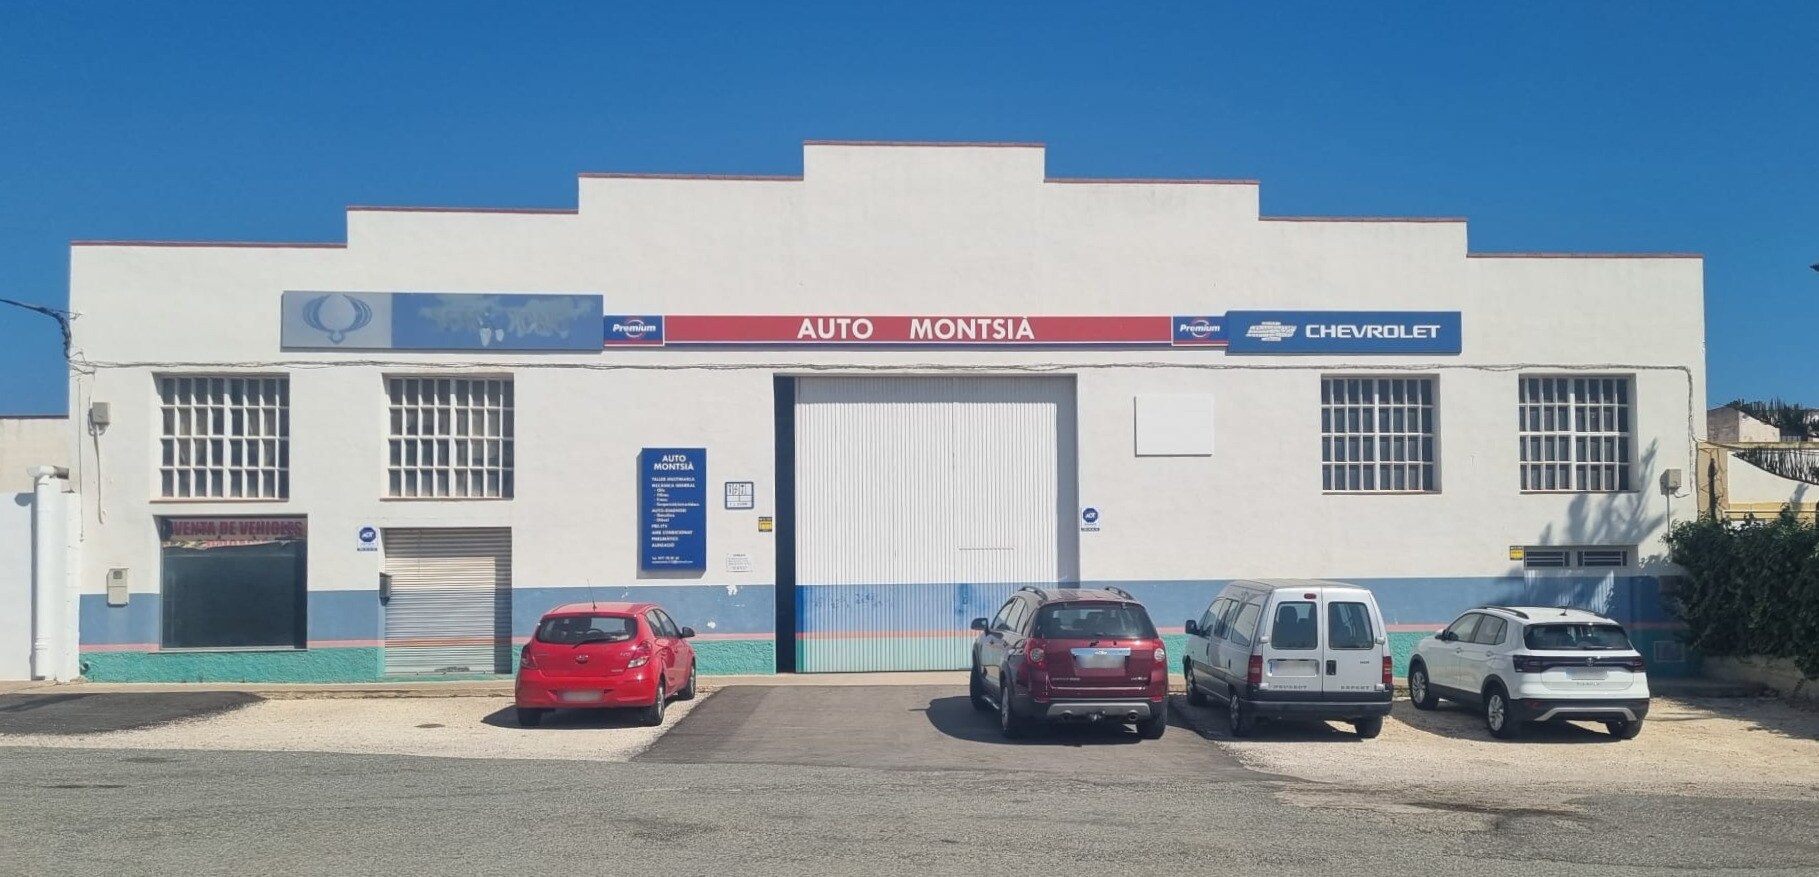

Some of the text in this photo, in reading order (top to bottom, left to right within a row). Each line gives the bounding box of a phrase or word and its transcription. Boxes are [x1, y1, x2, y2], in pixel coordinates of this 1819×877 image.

[612, 323, 656, 332] Premium
[797, 316, 1035, 340] AUTO MONTSIÀ
[1180, 324, 1220, 332] Premium
[1305, 324, 1441, 338] CHEVROLET
[173, 521, 217, 535] VENTA
[219, 521, 237, 535] DE
